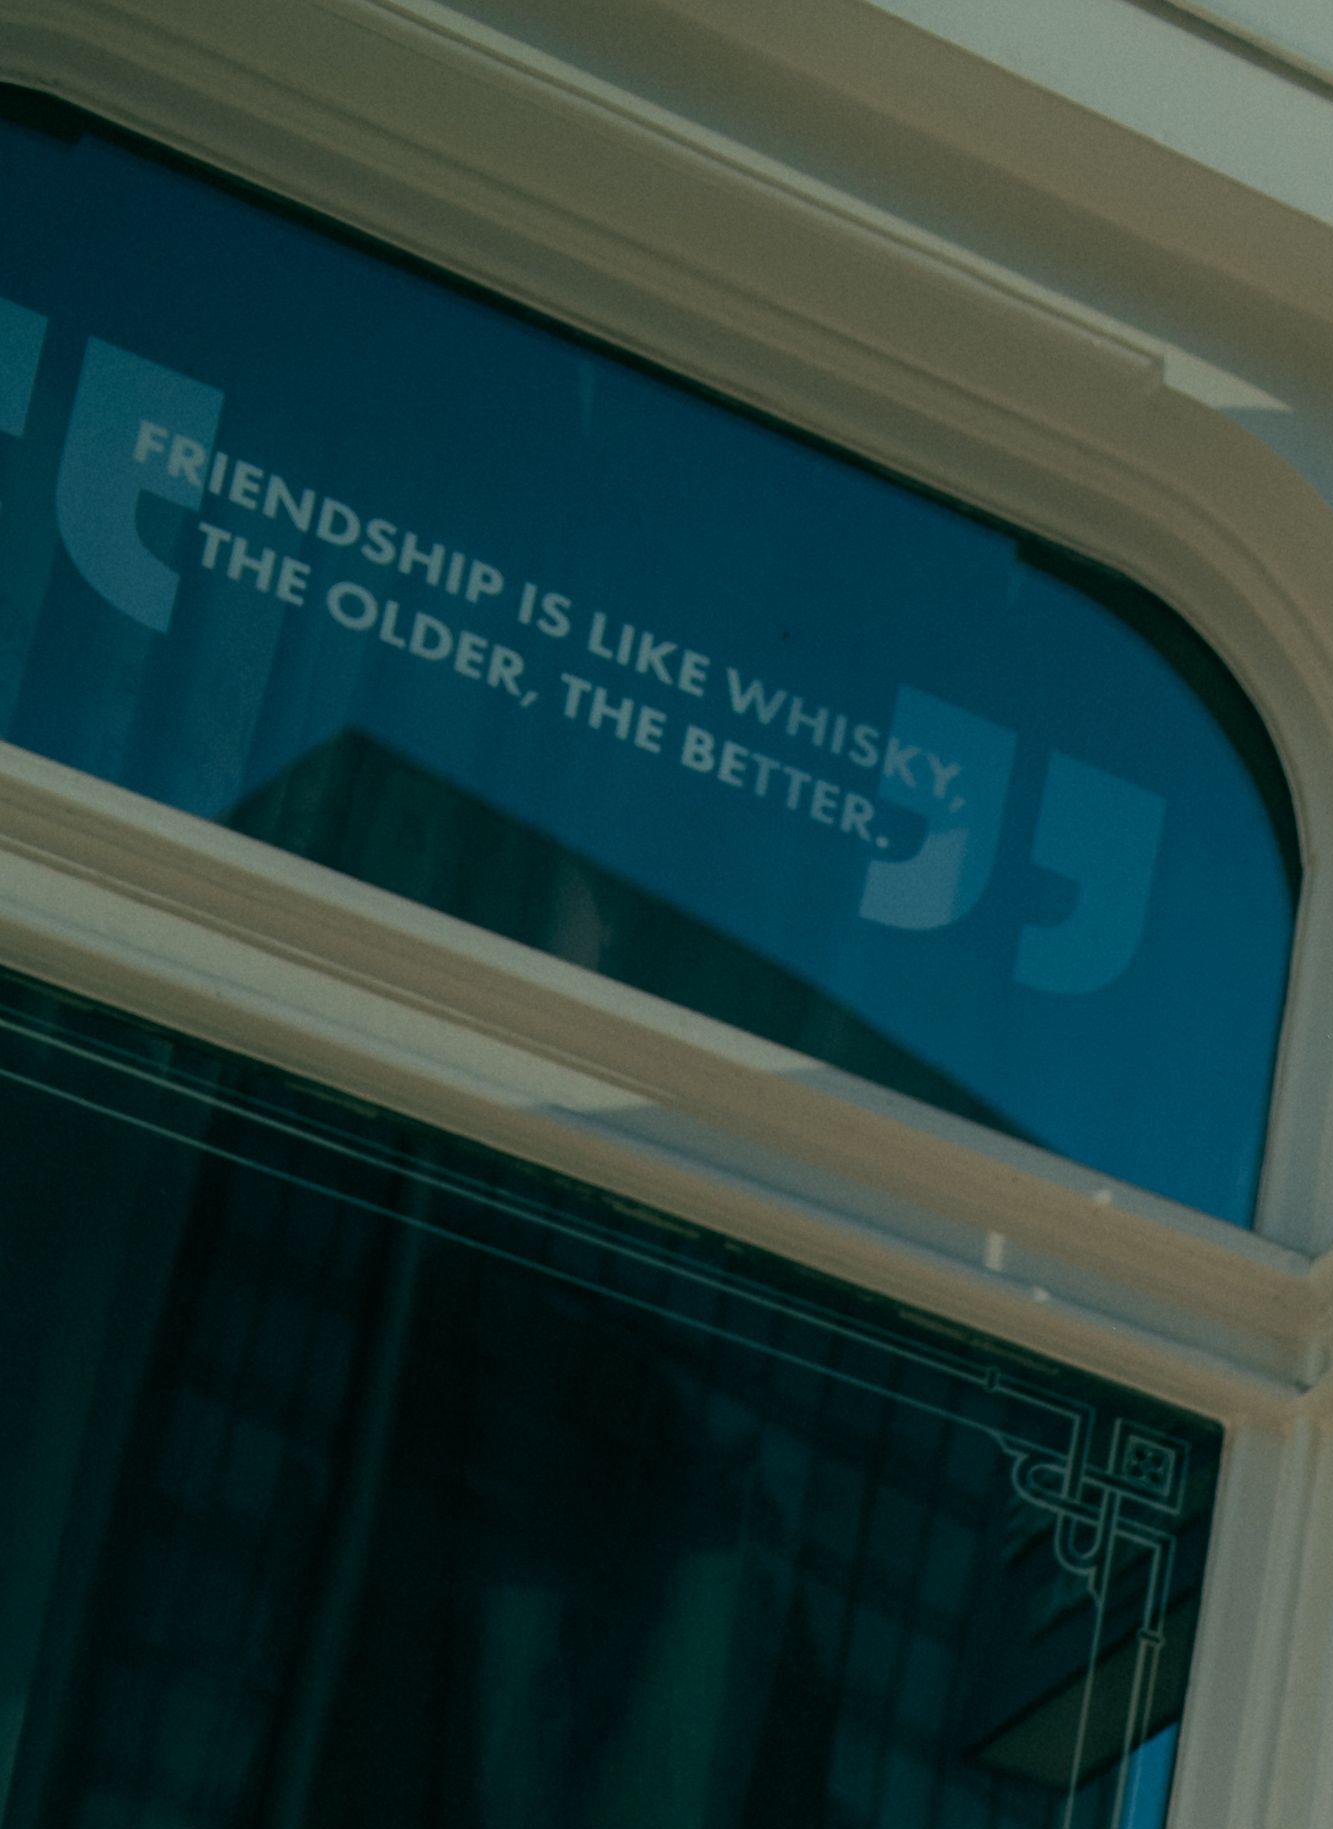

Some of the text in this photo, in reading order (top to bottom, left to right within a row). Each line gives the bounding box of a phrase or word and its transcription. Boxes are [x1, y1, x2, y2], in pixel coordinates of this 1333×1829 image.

[134, 421, 965, 815] FRIENDSHIP IS LIKE WHISKY,
[199, 525, 890, 848] THE OLDER, THE BETTER.
